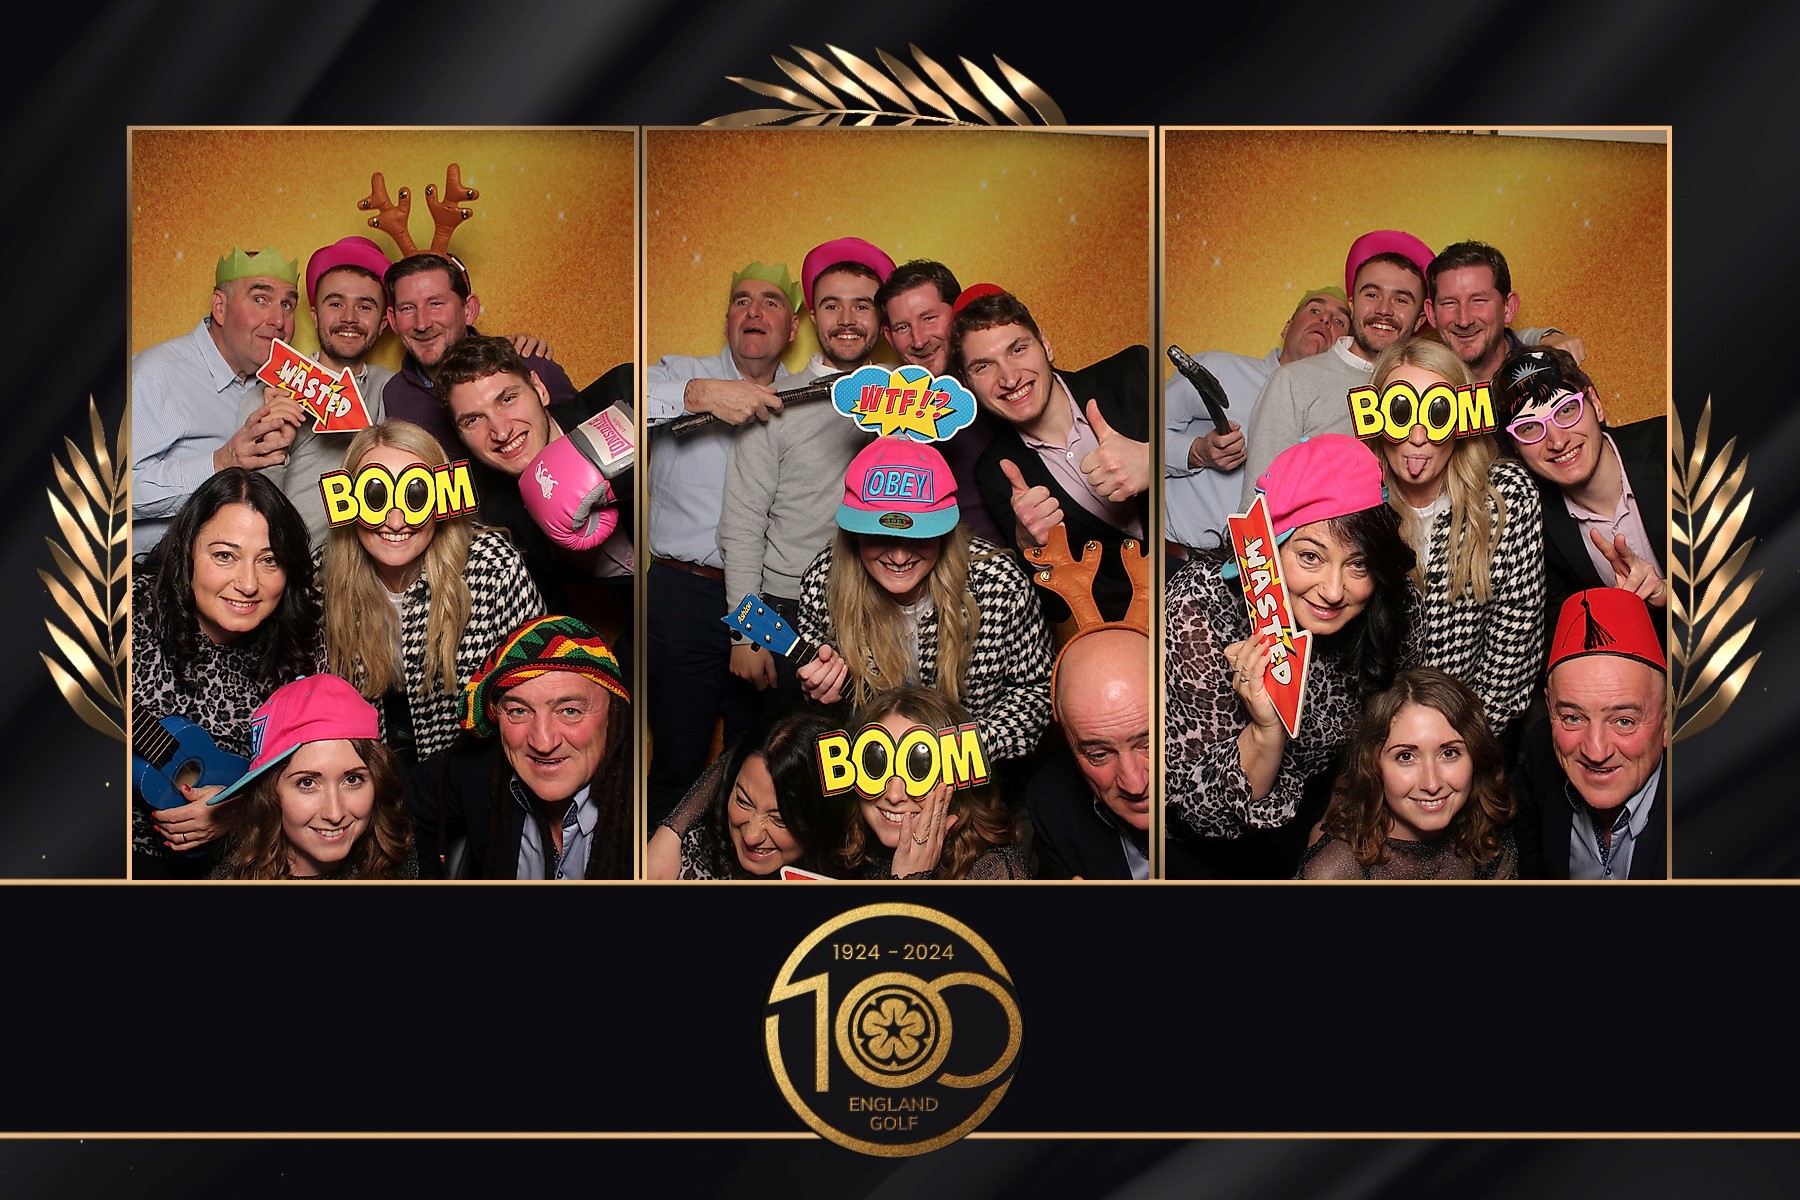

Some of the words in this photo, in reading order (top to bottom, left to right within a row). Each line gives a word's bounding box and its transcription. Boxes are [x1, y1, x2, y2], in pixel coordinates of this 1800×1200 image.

[279, 358, 352, 418] WASTED
[859, 385, 951, 419] WTF!?
[1347, 380, 1498, 444] BOOM
[588, 411, 634, 459] LONSDALE
[319, 460, 478, 528] BOOM
[867, 470, 928, 498] OBEY
[1244, 537, 1292, 686] WASTED
[815, 722, 992, 800] BOOM
